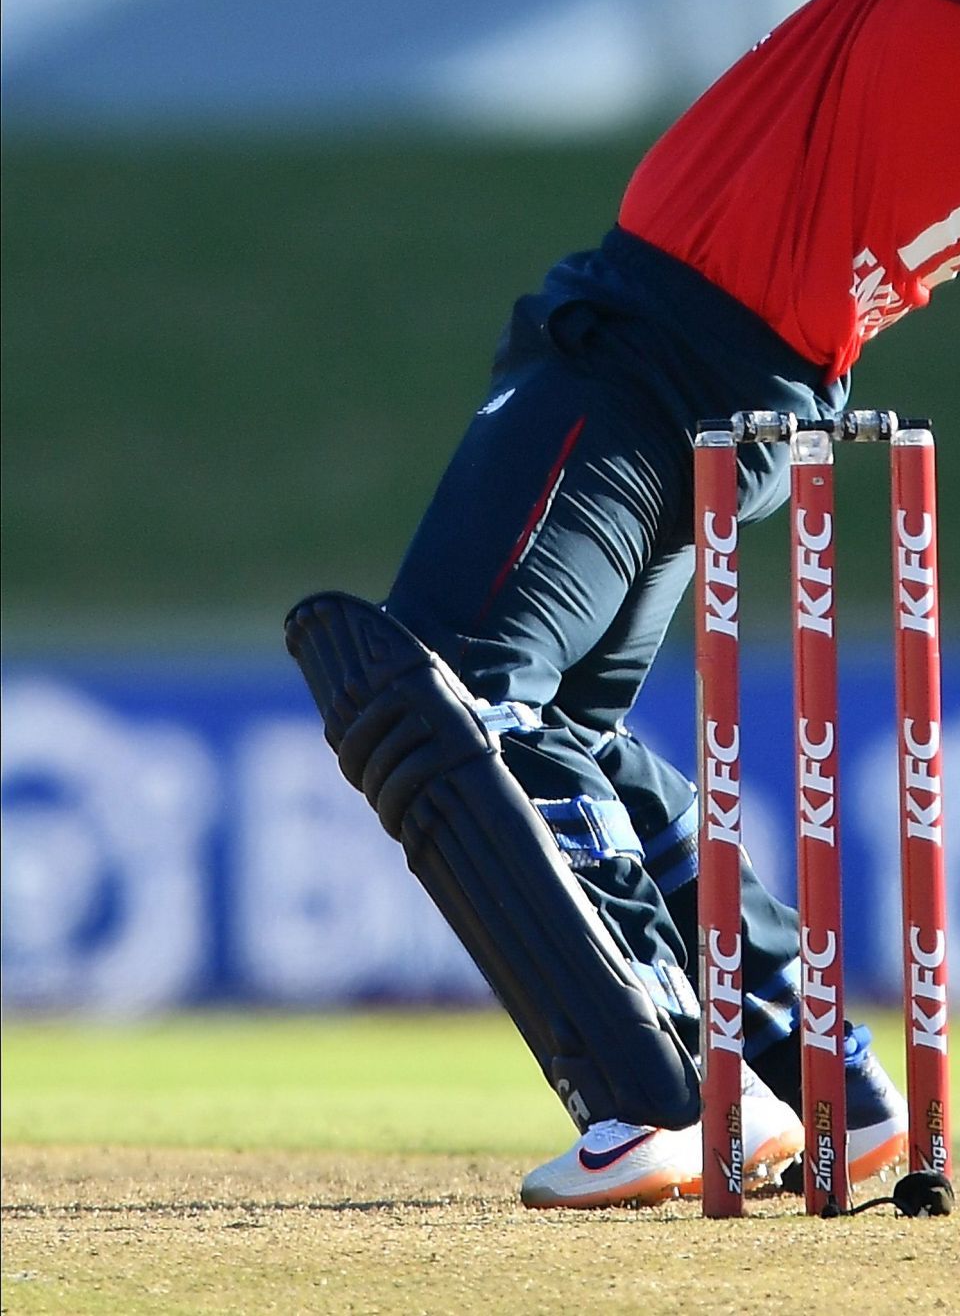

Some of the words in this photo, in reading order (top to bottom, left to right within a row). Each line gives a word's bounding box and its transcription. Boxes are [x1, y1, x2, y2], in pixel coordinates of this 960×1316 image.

[704, 507, 739, 639] KFC
[796, 508, 832, 638] KFC
[896, 510, 936, 637] KFC
[706, 719, 740, 845] KFC
[800, 718, 834, 846] KFC
[903, 718, 942, 847] KFC
[709, 928, 742, 1057] KFC
[801, 926, 837, 1056] KFC
[910, 926, 947, 1055] KFC
[815, 1100, 835, 1192] Zings.biz
[928, 1100, 948, 1172] ngs.biz
